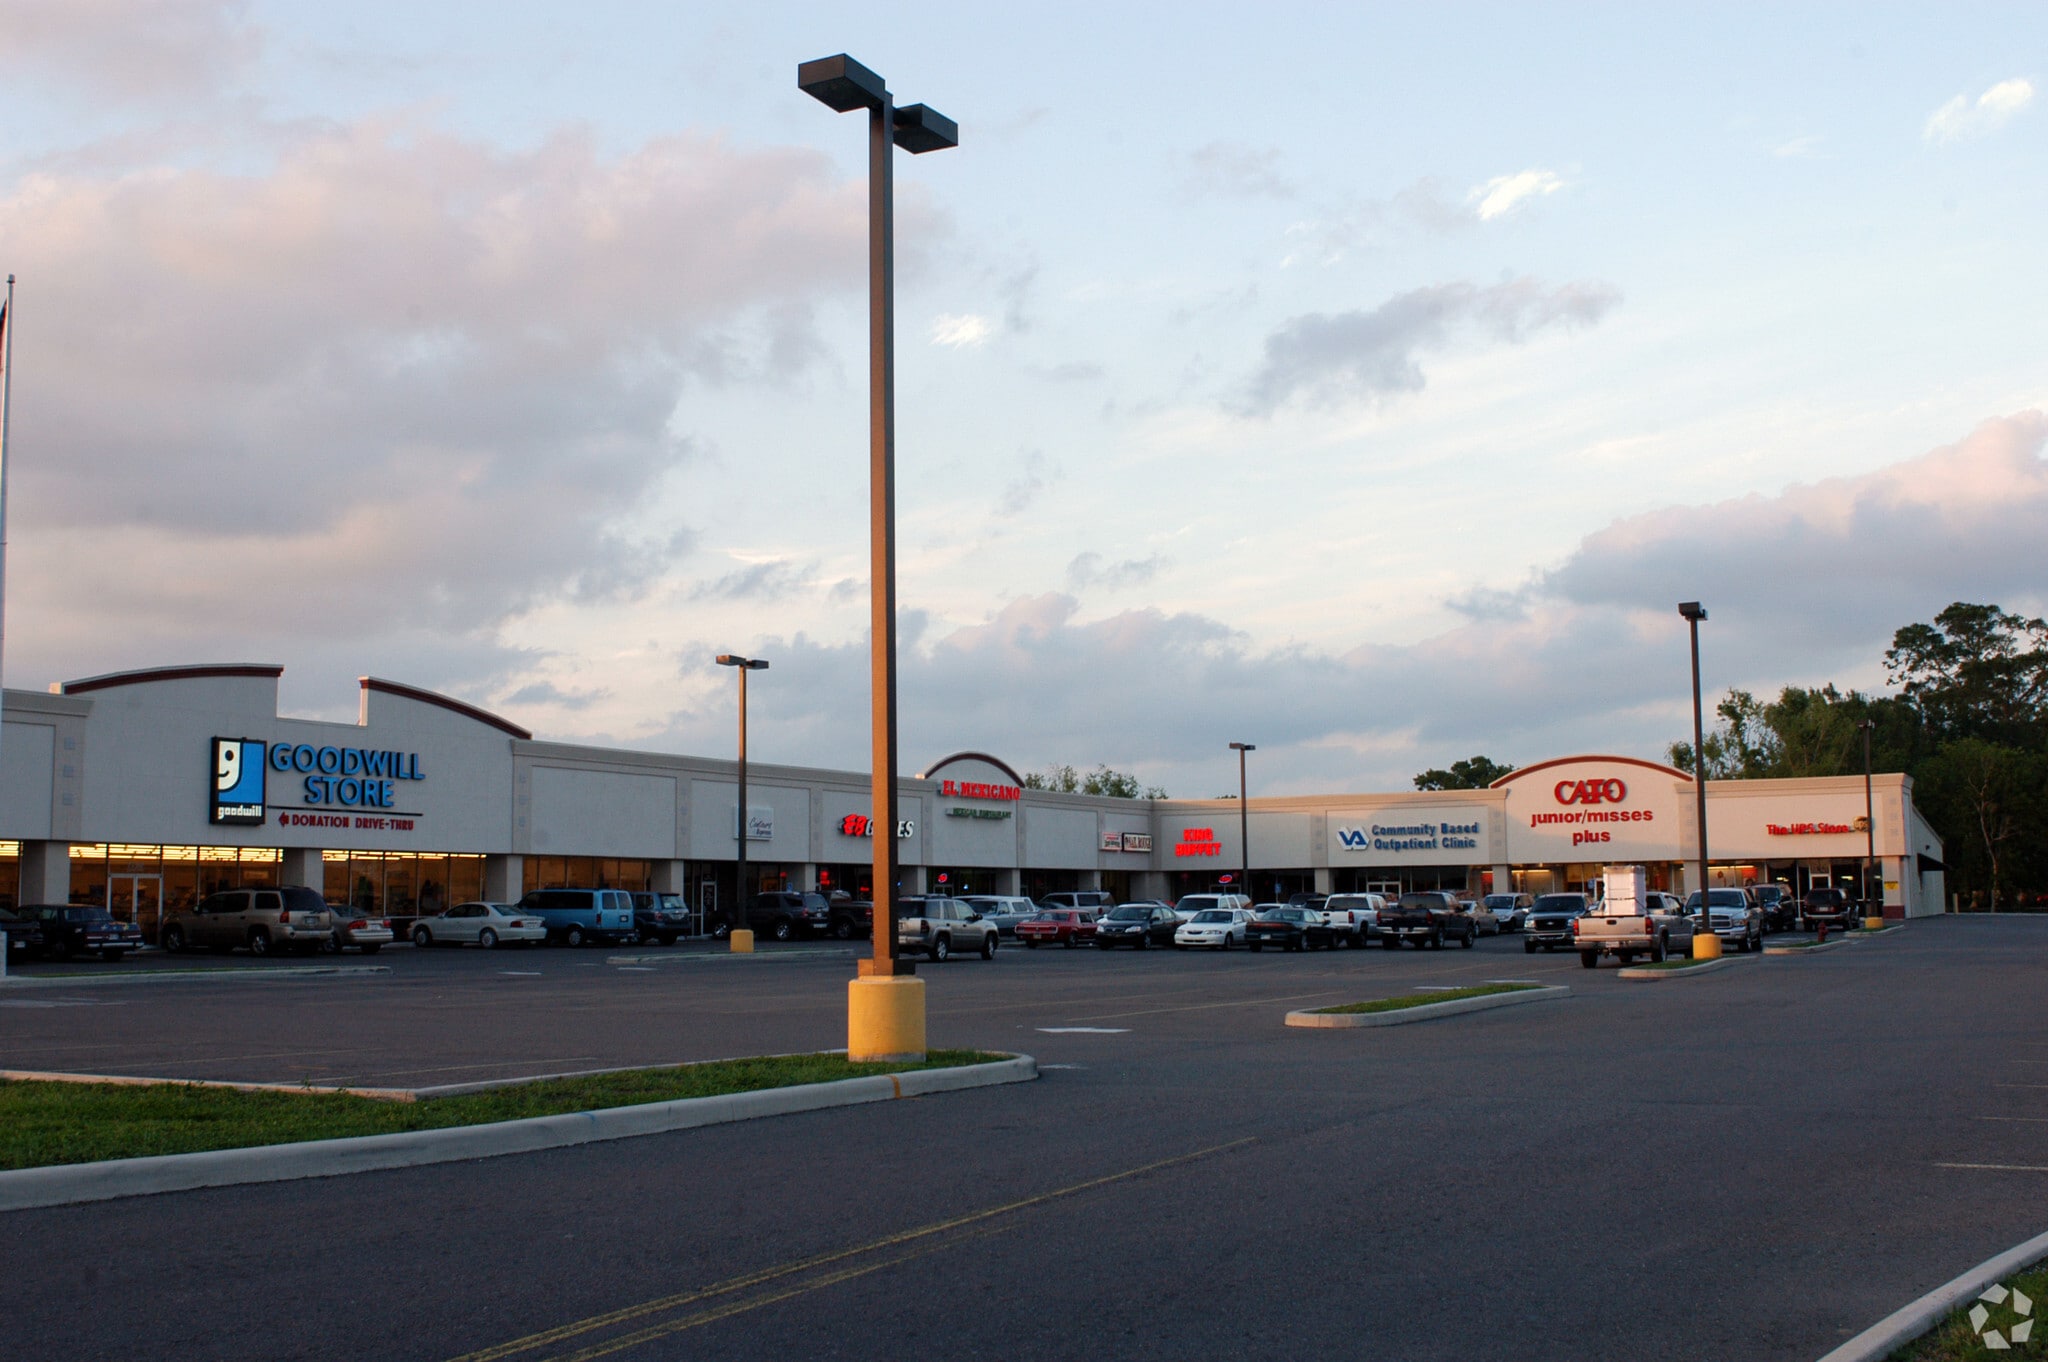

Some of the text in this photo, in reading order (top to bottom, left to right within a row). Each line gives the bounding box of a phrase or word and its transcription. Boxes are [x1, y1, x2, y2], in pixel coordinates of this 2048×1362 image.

[270, 743, 426, 780] GOODWILL
[304, 775, 394, 807] STORE
[942, 780, 1020, 800] EL MEXICANO
[1554, 778, 1626, 805] CATO
[217, 805, 262, 819] goodwill
[1531, 809, 1653, 828] junior/misses
[292, 814, 414, 830] DONATION DRIVE-THRU
[842, 813, 914, 838] EB GES
[1371, 822, 1479, 837] Community Based
[1766, 822, 1850, 835] The UPS Store
[1183, 827, 1213, 841] KING
[1338, 830, 1368, 846] VA
[1572, 829, 1611, 846] plus
[1175, 842, 1221, 857] BUFFET
[1374, 836, 1476, 852] Outpatient Clinic
